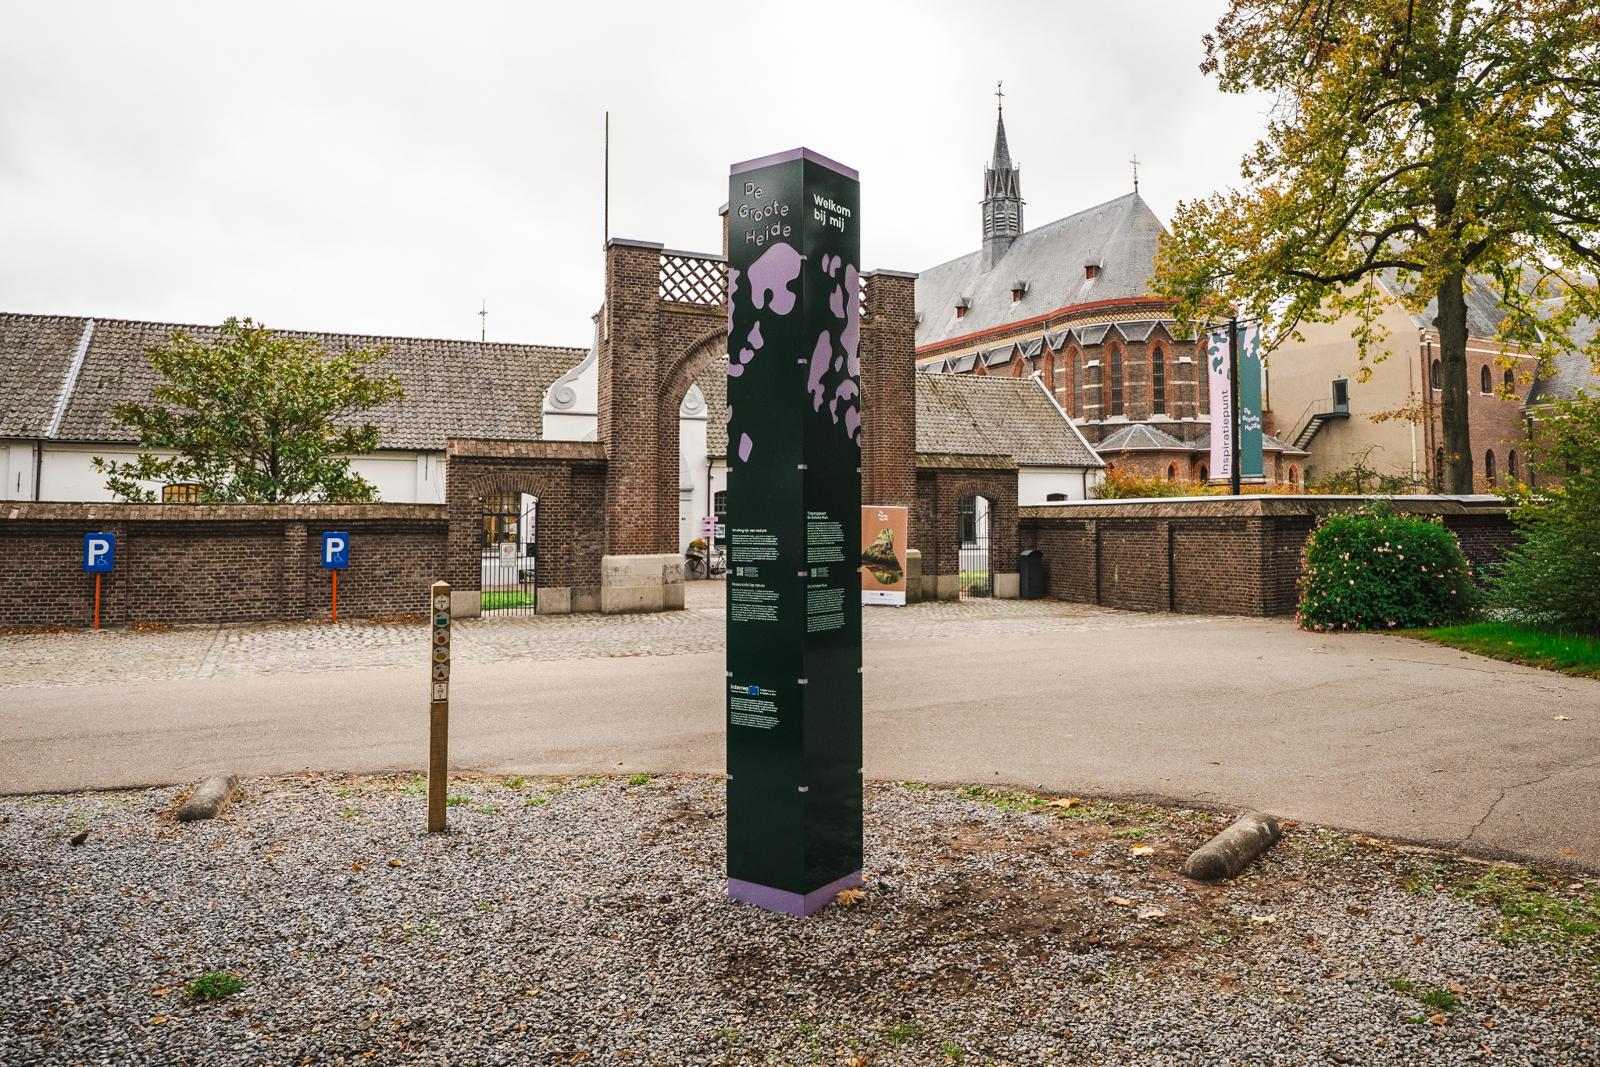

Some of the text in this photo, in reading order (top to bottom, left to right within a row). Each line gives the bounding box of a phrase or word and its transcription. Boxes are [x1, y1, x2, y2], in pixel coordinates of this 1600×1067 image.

[744, 182, 763, 199] De
[738, 200, 789, 221] Groote
[813, 193, 851, 218] Welkom
[814, 208, 845, 232] bij mij
[745, 221, 792, 246] Heide
[1242, 415, 1260, 423] Groote
[1244, 422, 1260, 432] Heide
[1221, 389, 1230, 475] Inspiratiepunt
[88, 539, 110, 566] P
[326, 537, 345, 563] P
